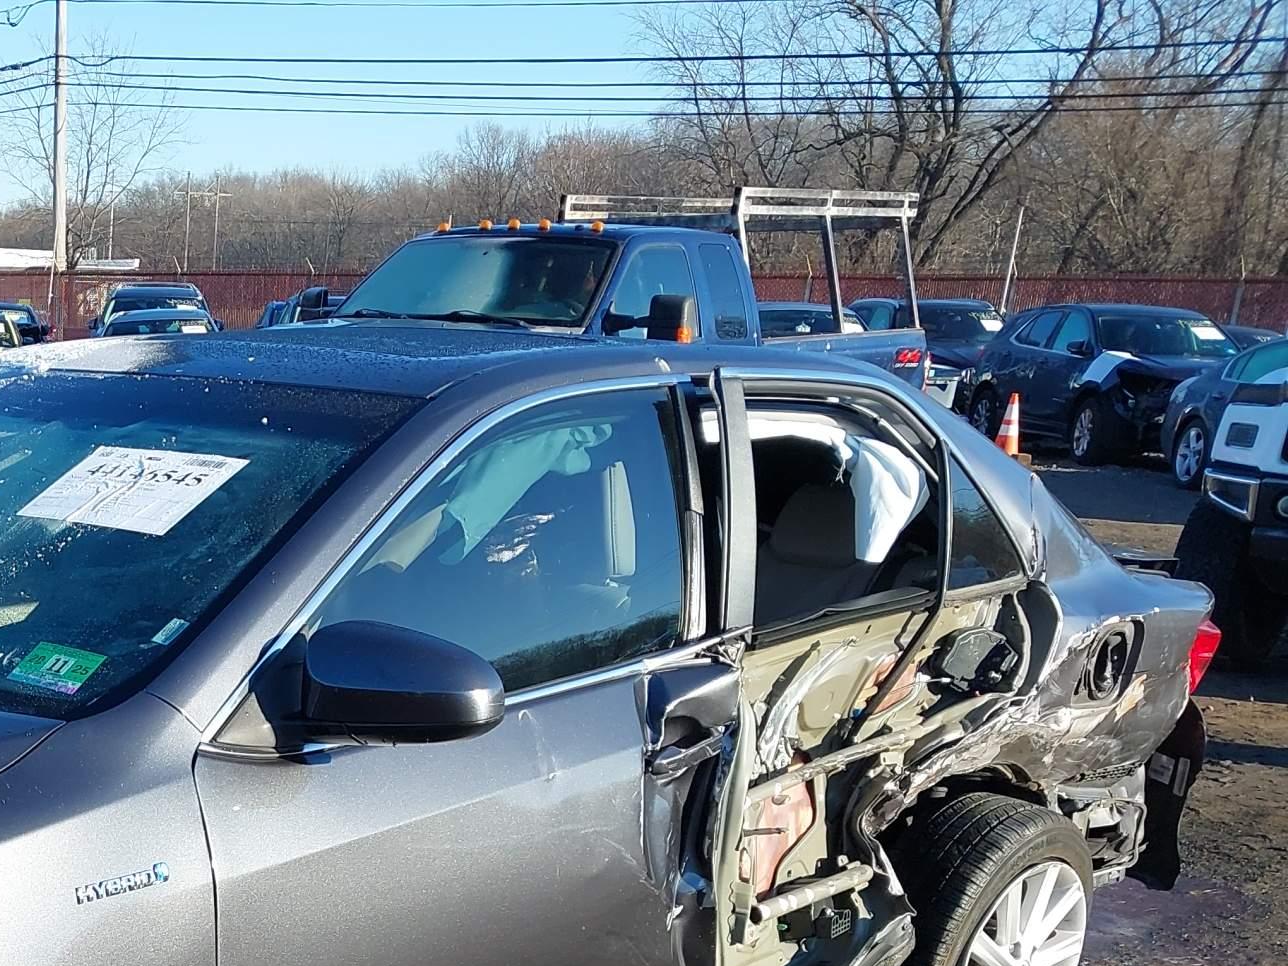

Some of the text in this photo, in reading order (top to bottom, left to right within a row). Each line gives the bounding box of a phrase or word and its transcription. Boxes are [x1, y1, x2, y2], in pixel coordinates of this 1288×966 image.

[47, 657, 68, 673] 11
[72, 664, 89, 675] 25
[75, 869, 156, 905] HYBRID
